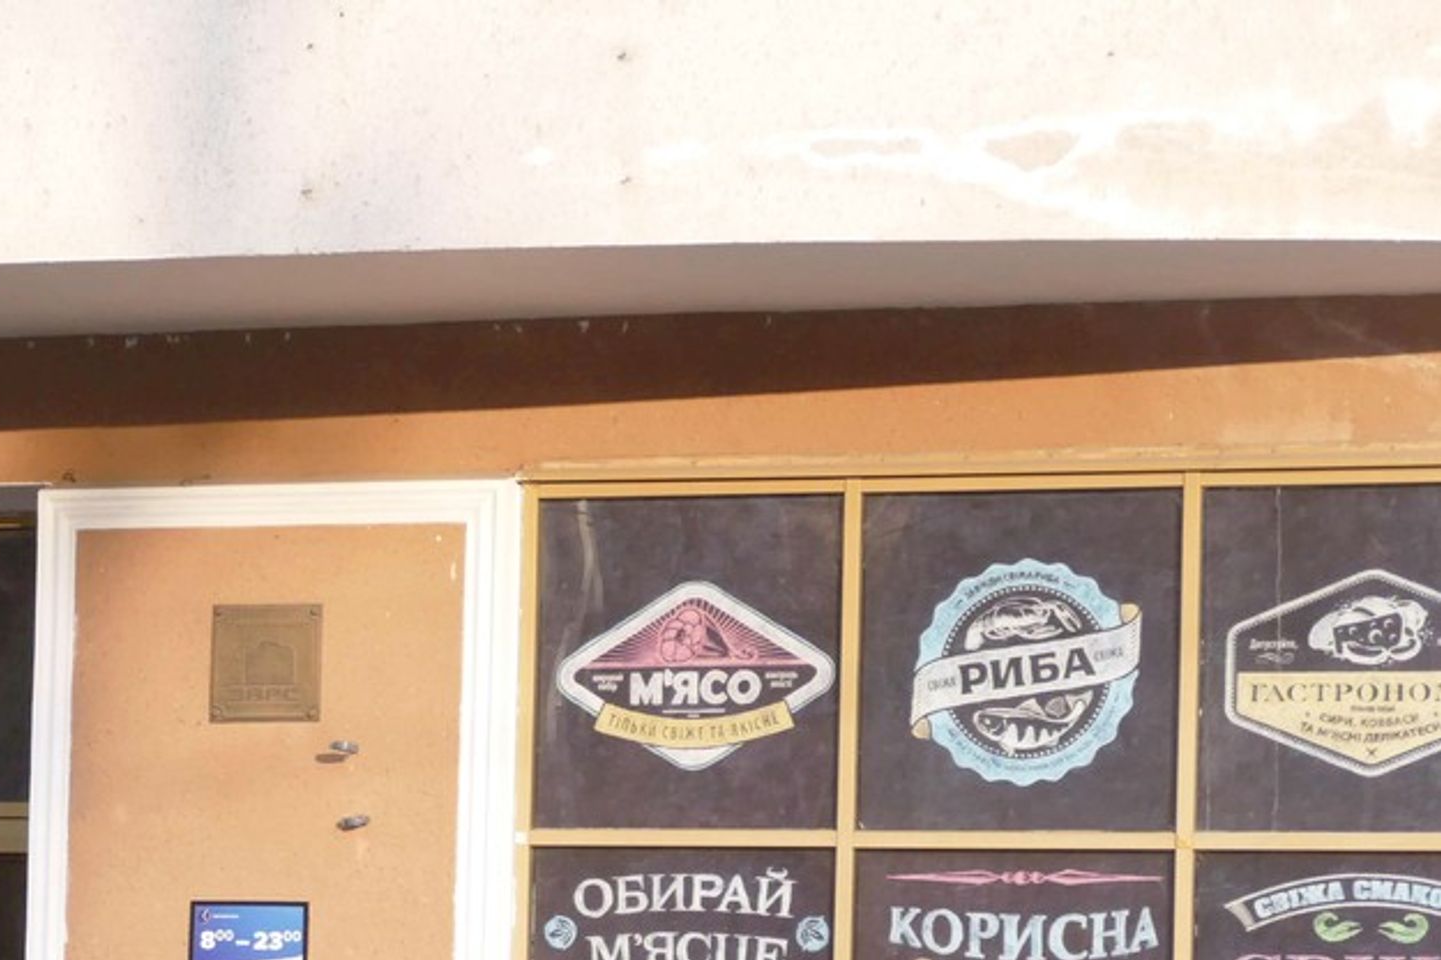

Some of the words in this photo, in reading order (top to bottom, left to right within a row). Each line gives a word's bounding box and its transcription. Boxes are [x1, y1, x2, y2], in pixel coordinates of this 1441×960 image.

[958, 647, 1095, 695] РИБА
[1250, 683, 1441, 702] ГАСТРОНО
[574, 866, 798, 918] ОБИРАЙ
[1254, 881, 1345, 918] СВІЖА
